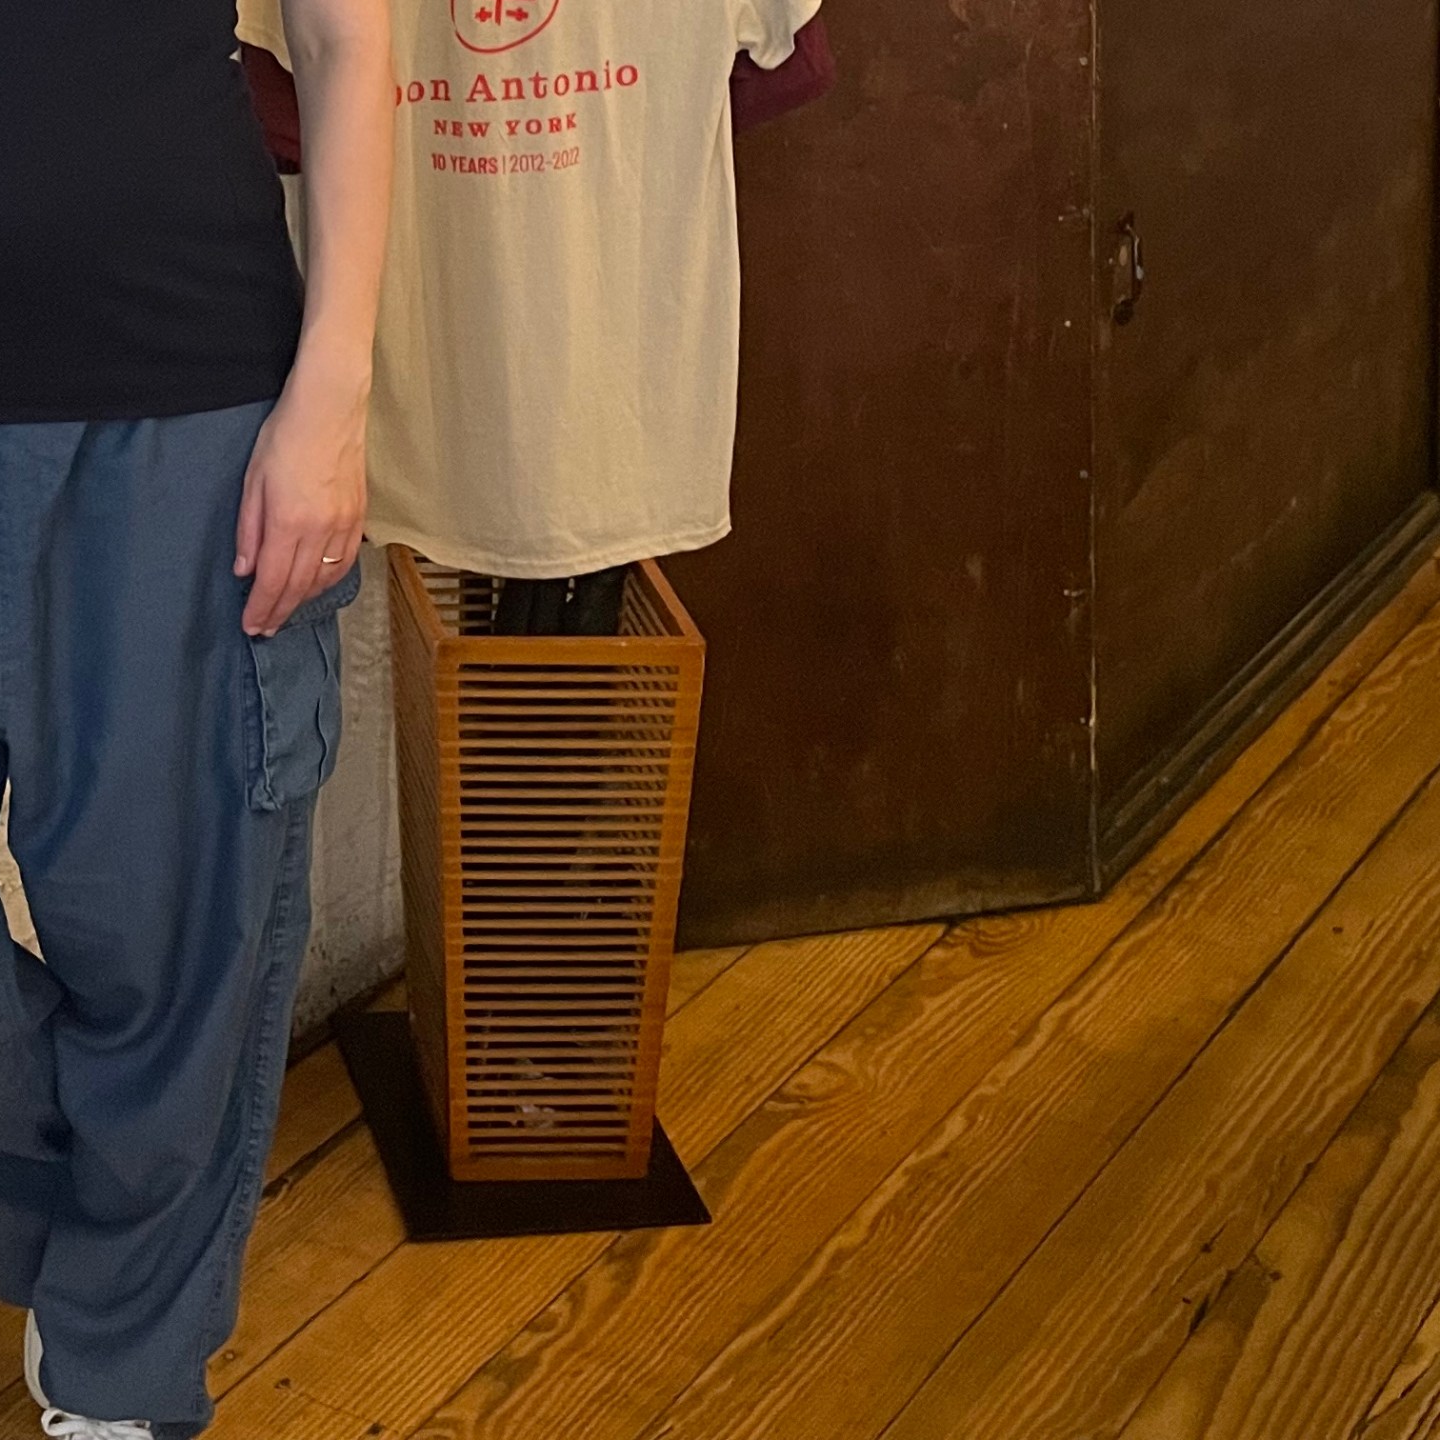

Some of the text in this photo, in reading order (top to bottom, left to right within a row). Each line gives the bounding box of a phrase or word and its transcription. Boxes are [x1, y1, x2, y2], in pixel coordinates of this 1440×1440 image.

[465, 60, 639, 103] Antonio
[433, 112, 578, 138] NEW YORK
[431, 152, 447, 172] 10
[450, 153, 499, 175] YEARS
